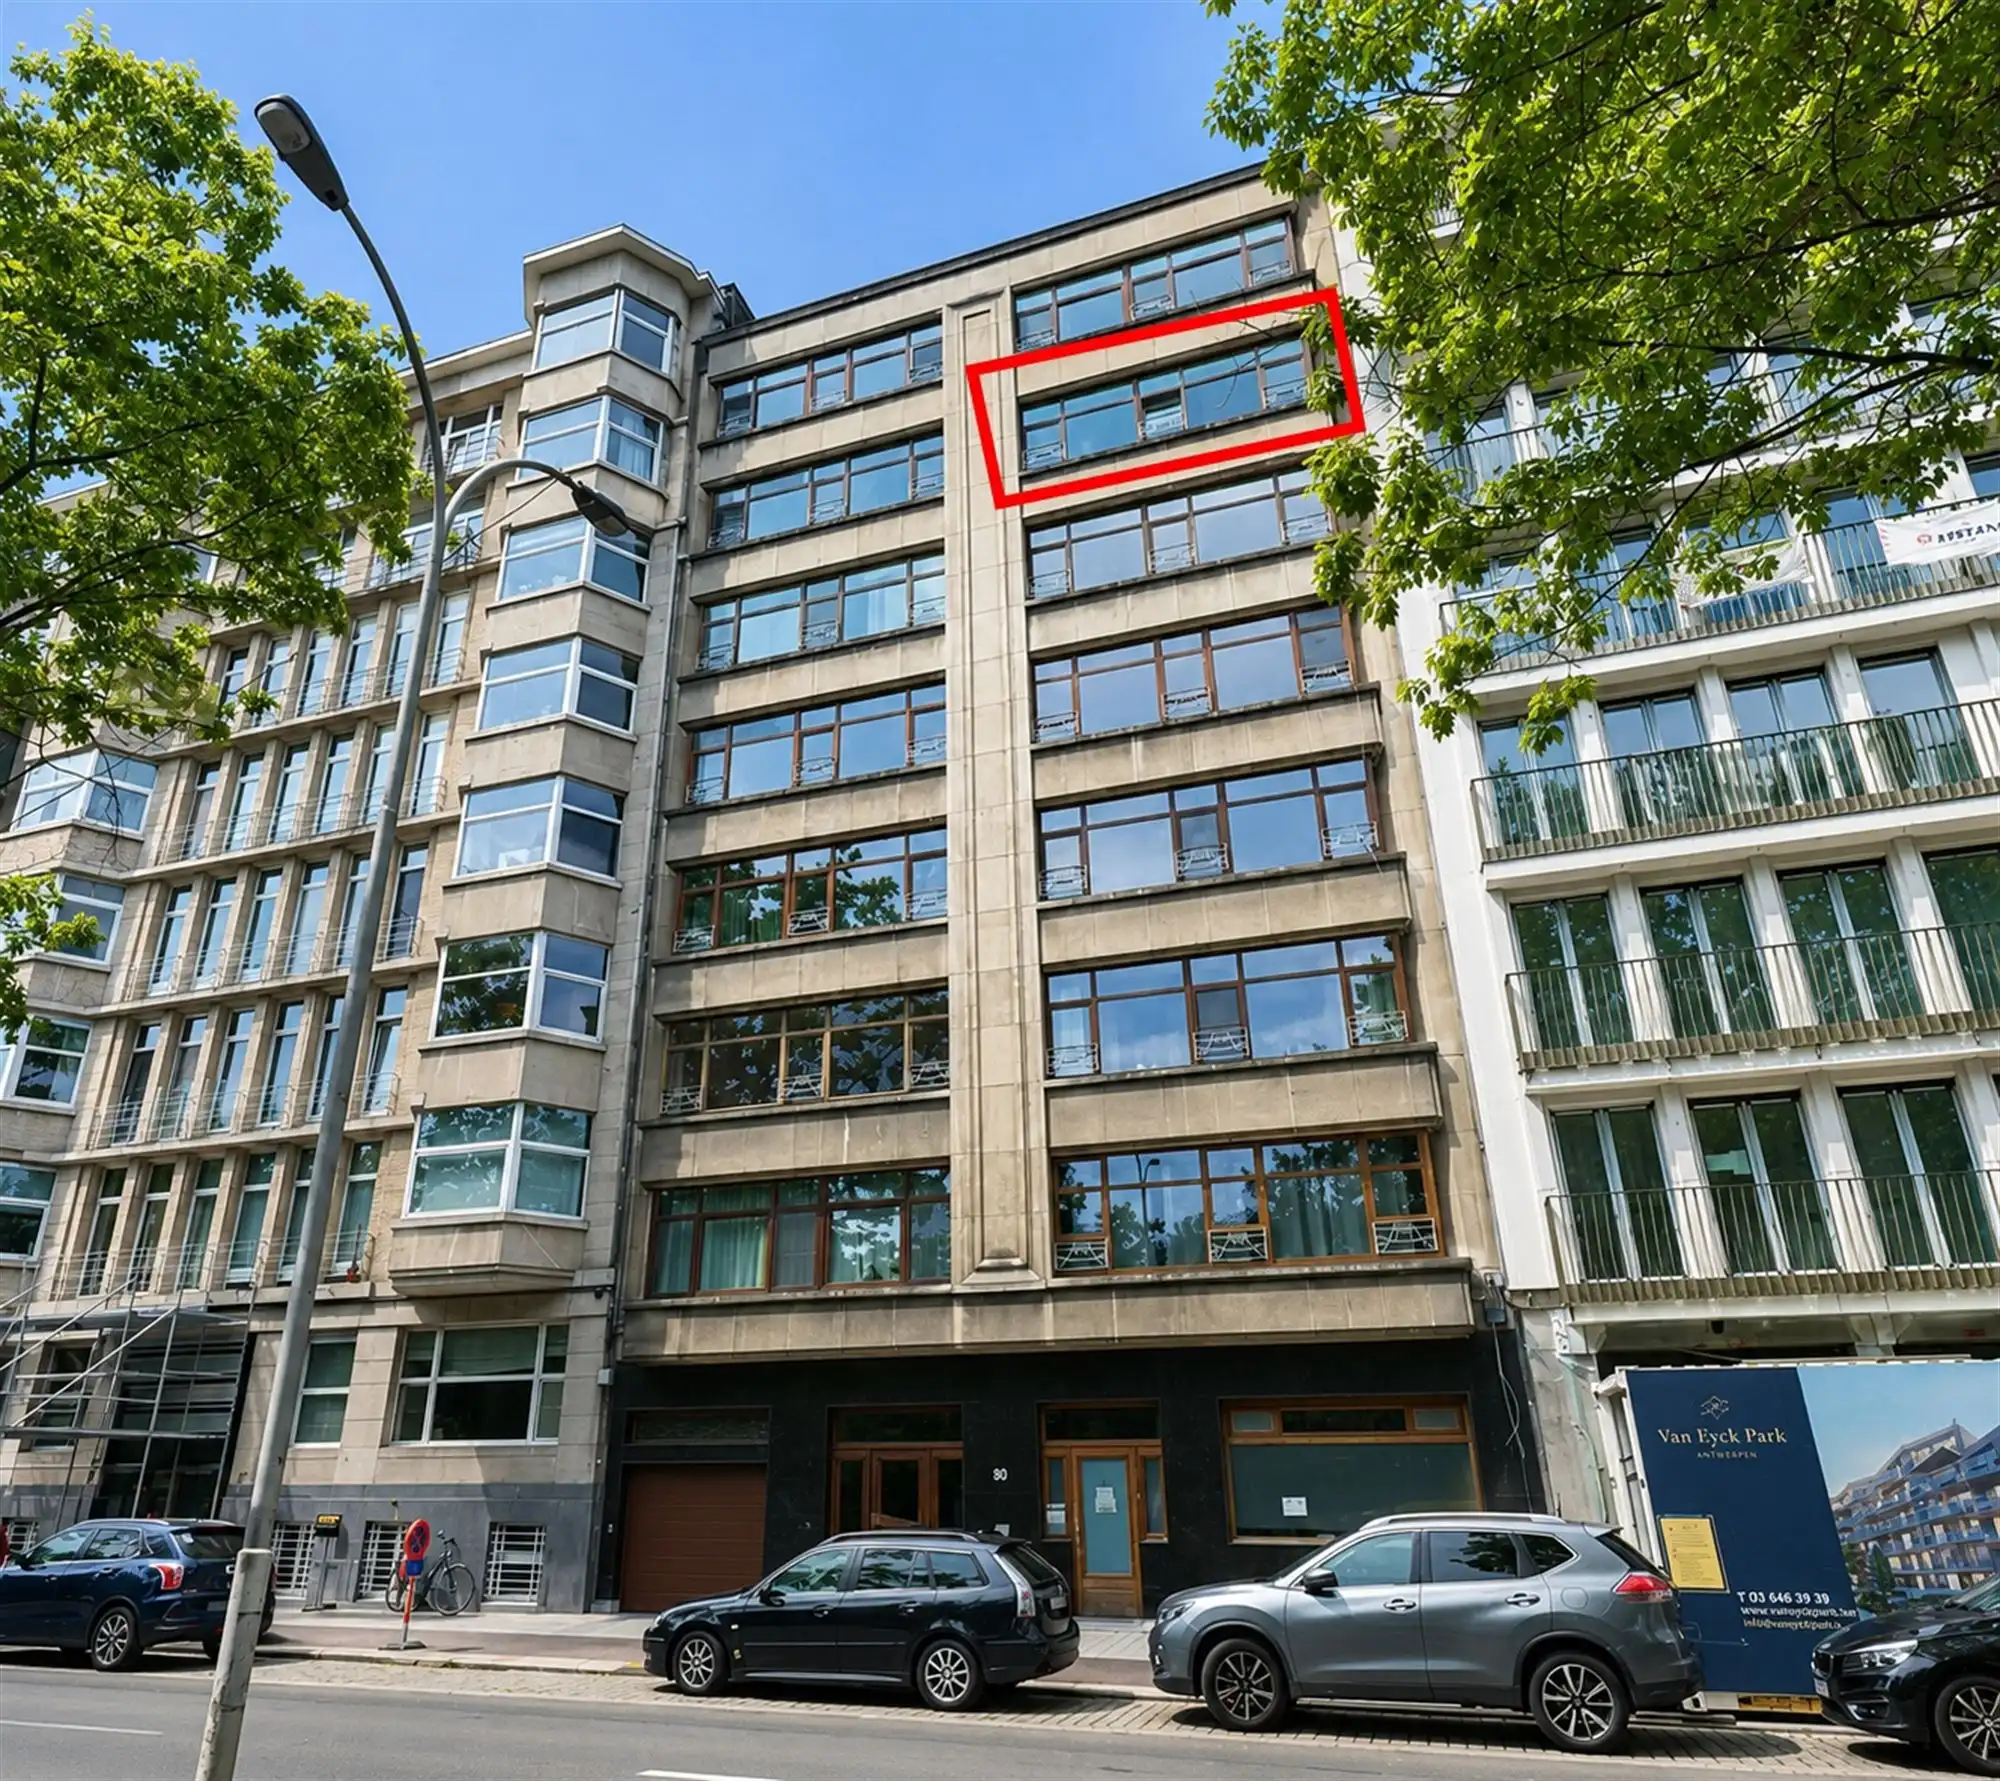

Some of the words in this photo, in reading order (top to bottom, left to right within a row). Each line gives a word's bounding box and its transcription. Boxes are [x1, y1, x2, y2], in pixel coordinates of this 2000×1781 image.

[1658, 1428, 1692, 1444] Van
[1697, 1428, 1741, 1448] Eyck
[1744, 1428, 1787, 1444] Park
[1737, 1591, 1746, 1603] T
[1748, 1591, 1766, 1604] 03
[1768, 1591, 1793, 1605] 646
[1794, 1592, 1811, 1605] 39
[1813, 1592, 1830, 1605] 39
